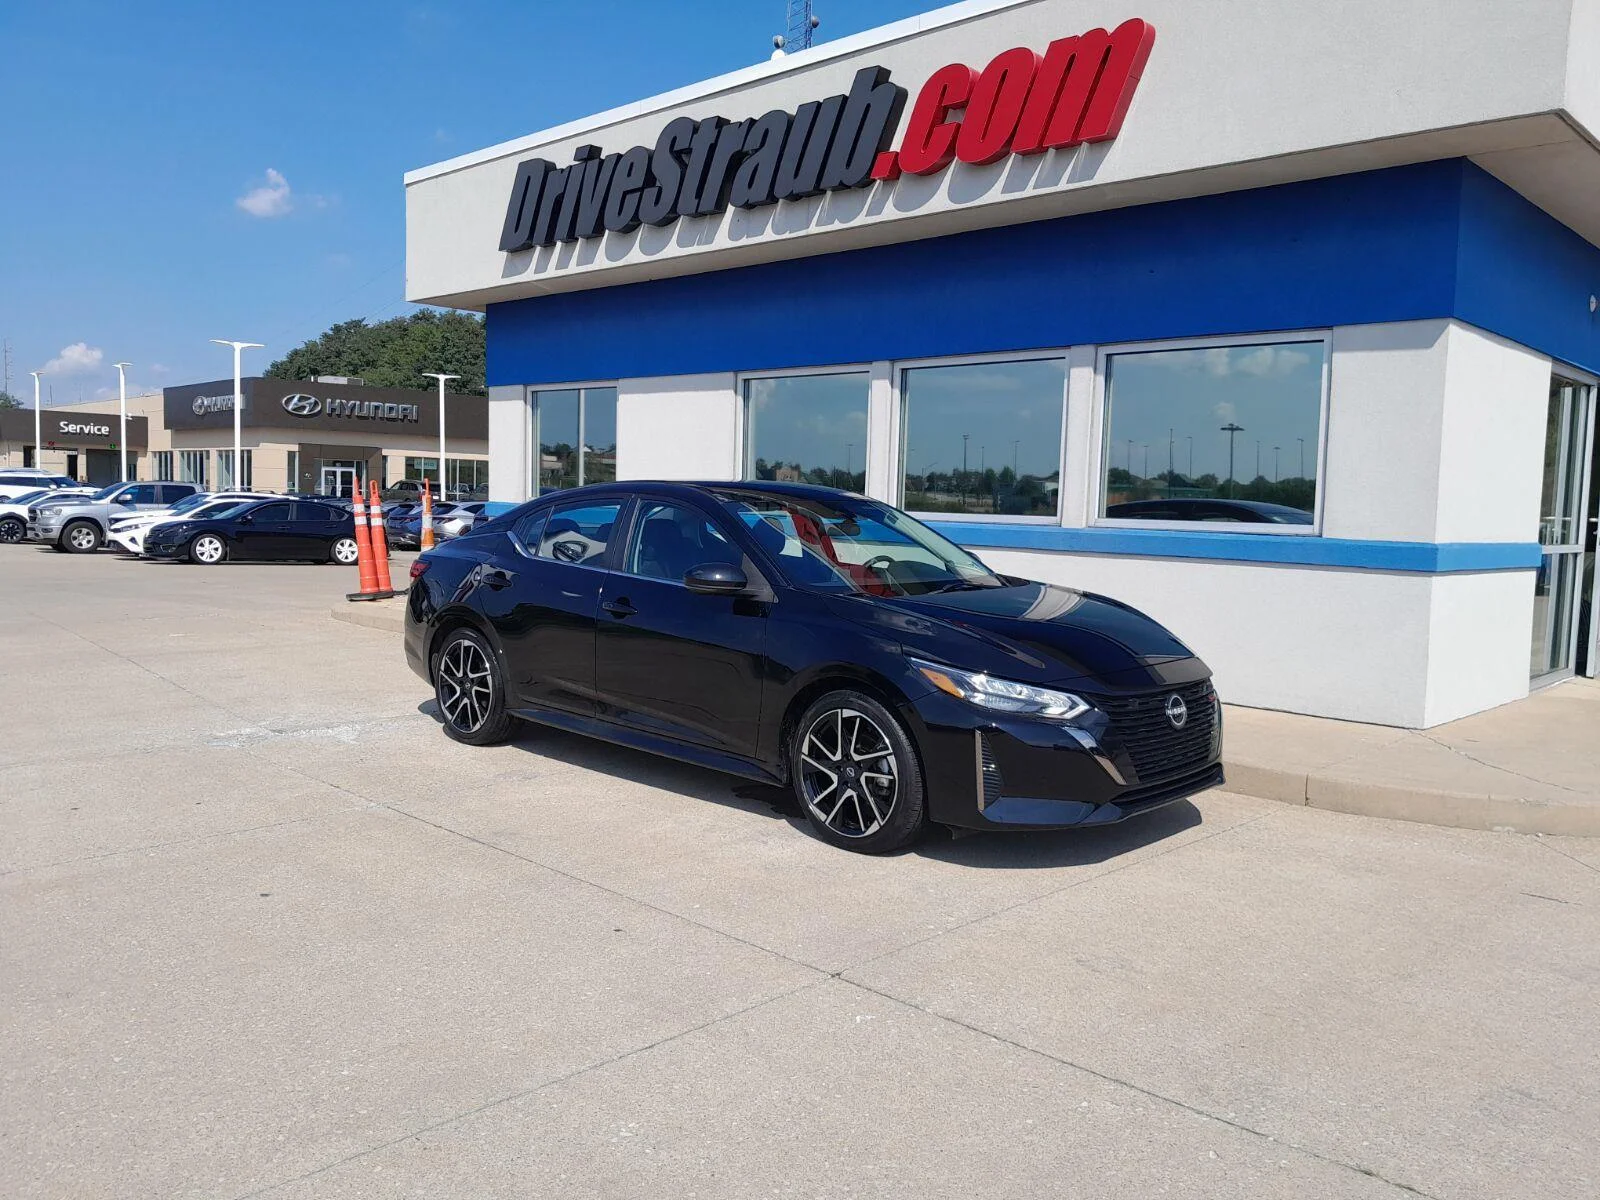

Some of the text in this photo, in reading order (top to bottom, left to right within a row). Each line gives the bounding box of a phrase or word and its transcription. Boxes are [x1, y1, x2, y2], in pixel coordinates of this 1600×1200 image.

[499, 17, 1156, 253] DriveStraub.com
[326, 398, 419, 421] HYUNDAI
[59, 421, 110, 435] Service
